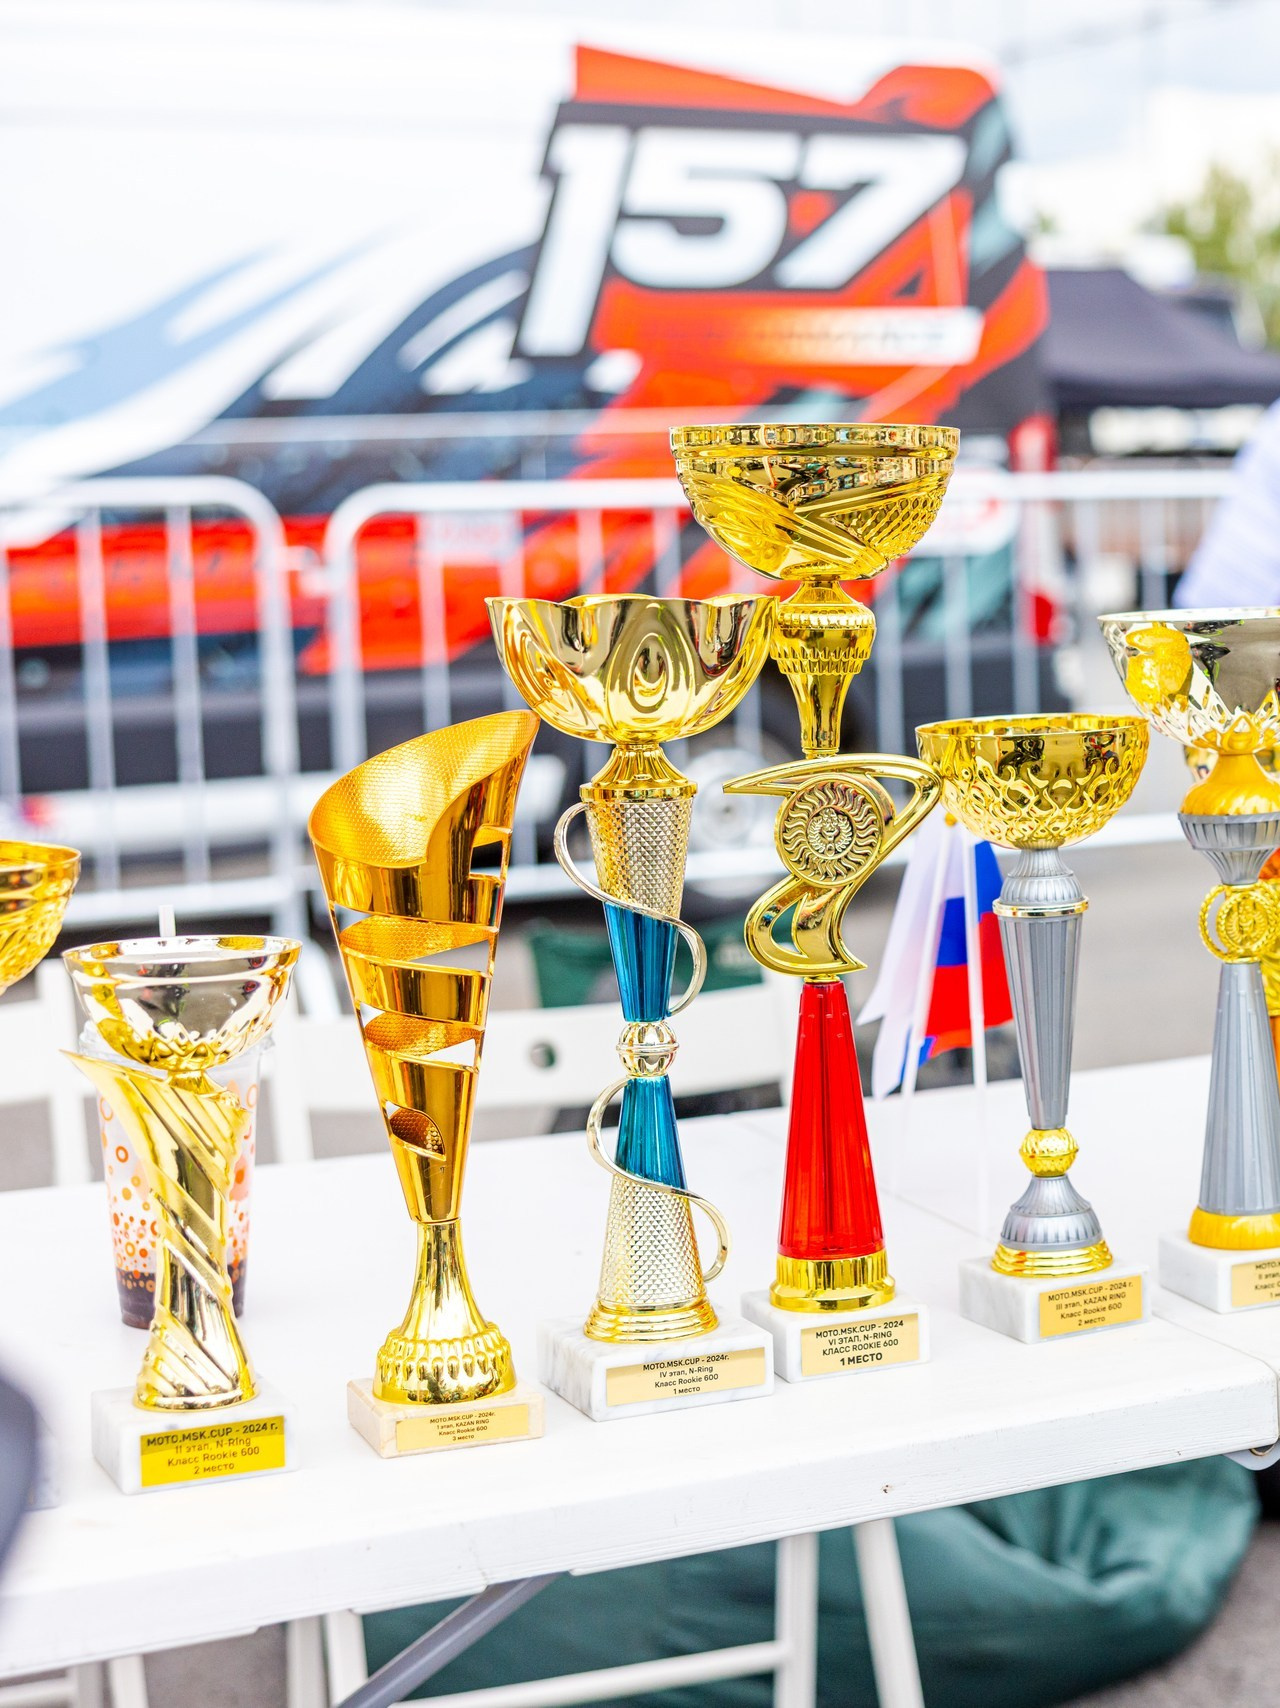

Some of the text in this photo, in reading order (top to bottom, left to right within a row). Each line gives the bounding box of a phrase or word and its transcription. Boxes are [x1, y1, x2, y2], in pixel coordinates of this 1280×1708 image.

[517, 124, 969, 356] 157
[1048, 1286, 1103, 1301] MOTO.MSK.CUP
[1110, 1282, 1126, 1290] 2024
[1084, 1296, 1107, 1305] KAZAN
[1061, 1311, 1081, 1319] Класс
[1083, 1306, 1106, 1315] Rookie
[816, 1324, 876, 1338] MOTO.MSK.CUP
[884, 1320, 903, 1329] 2024
[838, 1336, 861, 1344] ЭТАП,
[864, 1331, 891, 1340] N-RING
[823, 1339, 898, 1356] КЛАСС ROOKIE 600
[643, 1358, 700, 1371] MOTO.MSK.CUP
[848, 1353, 882, 1365] МЕСТО
[669, 1368, 687, 1377] этап,
[689, 1366, 713, 1374] N-Ring
[678, 1376, 702, 1385] Rookie
[679, 1386, 700, 1394] место
[430, 1414, 473, 1423] MOTO.MSK.CUP
[147, 1428, 232, 1446] MOTO.MSK.CUP
[243, 1423, 267, 1434] 2024
[216, 1438, 251, 1449] N-Ring
[168, 1447, 259, 1466] Класс Rookie 600
[204, 1463, 234, 1472] место
